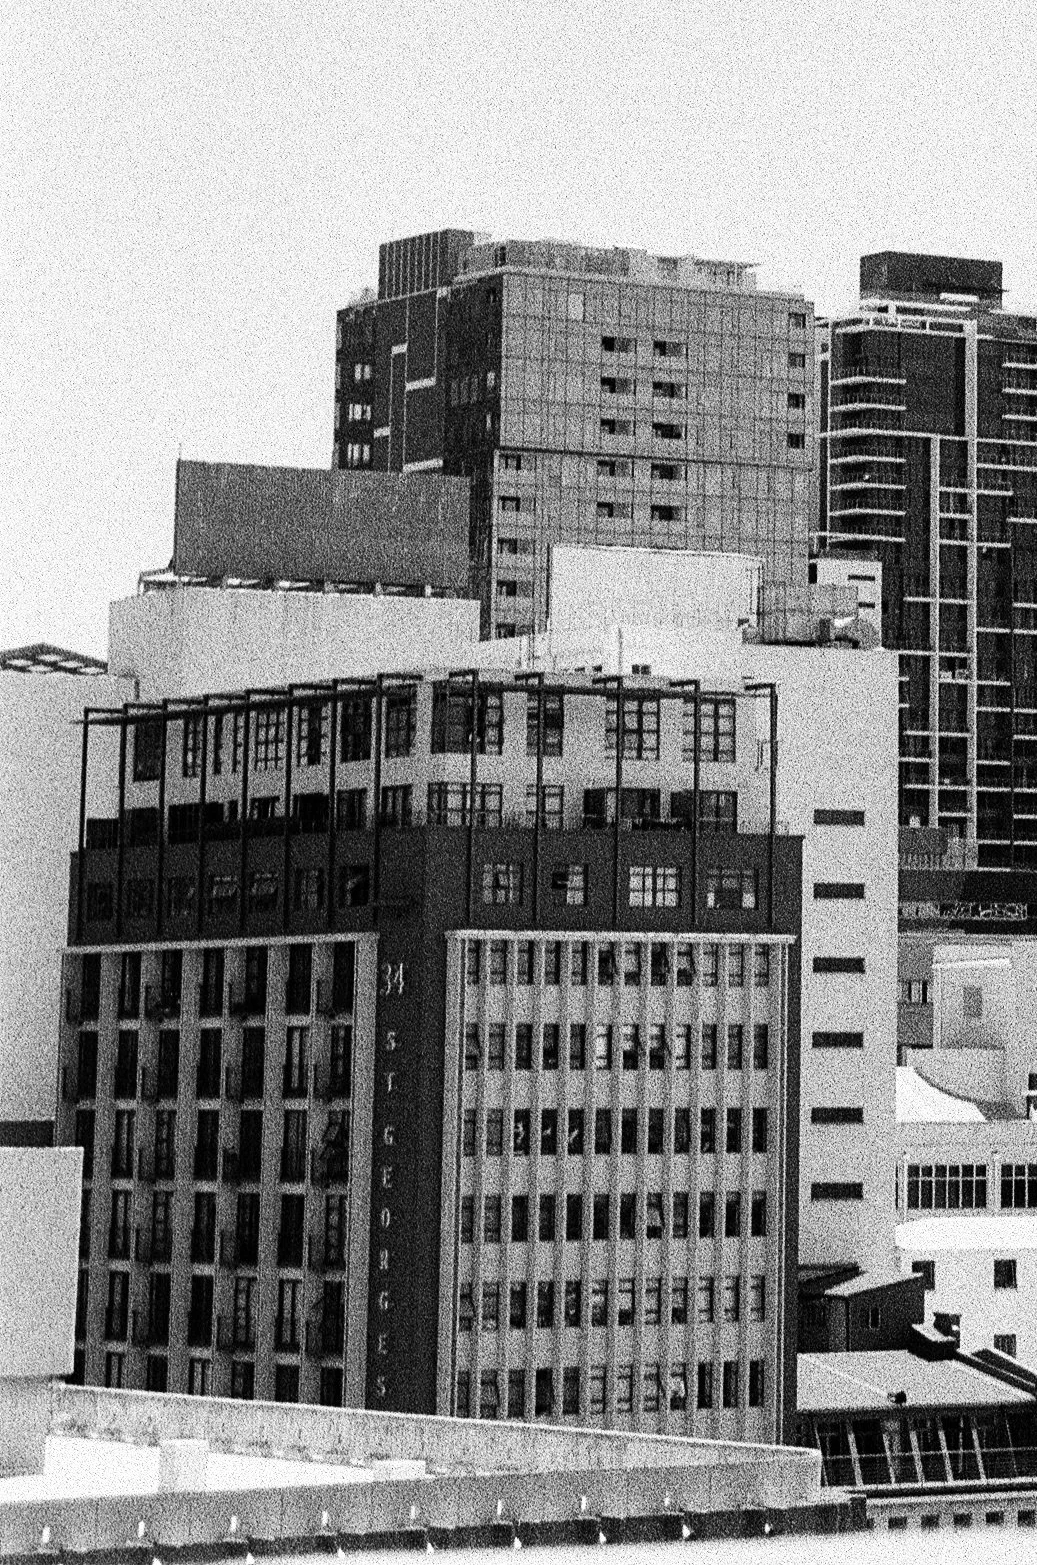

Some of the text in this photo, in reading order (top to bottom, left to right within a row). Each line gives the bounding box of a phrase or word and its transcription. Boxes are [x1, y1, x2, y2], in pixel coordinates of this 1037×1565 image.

[376, 962, 404, 1397] 34 ST GEORGES
